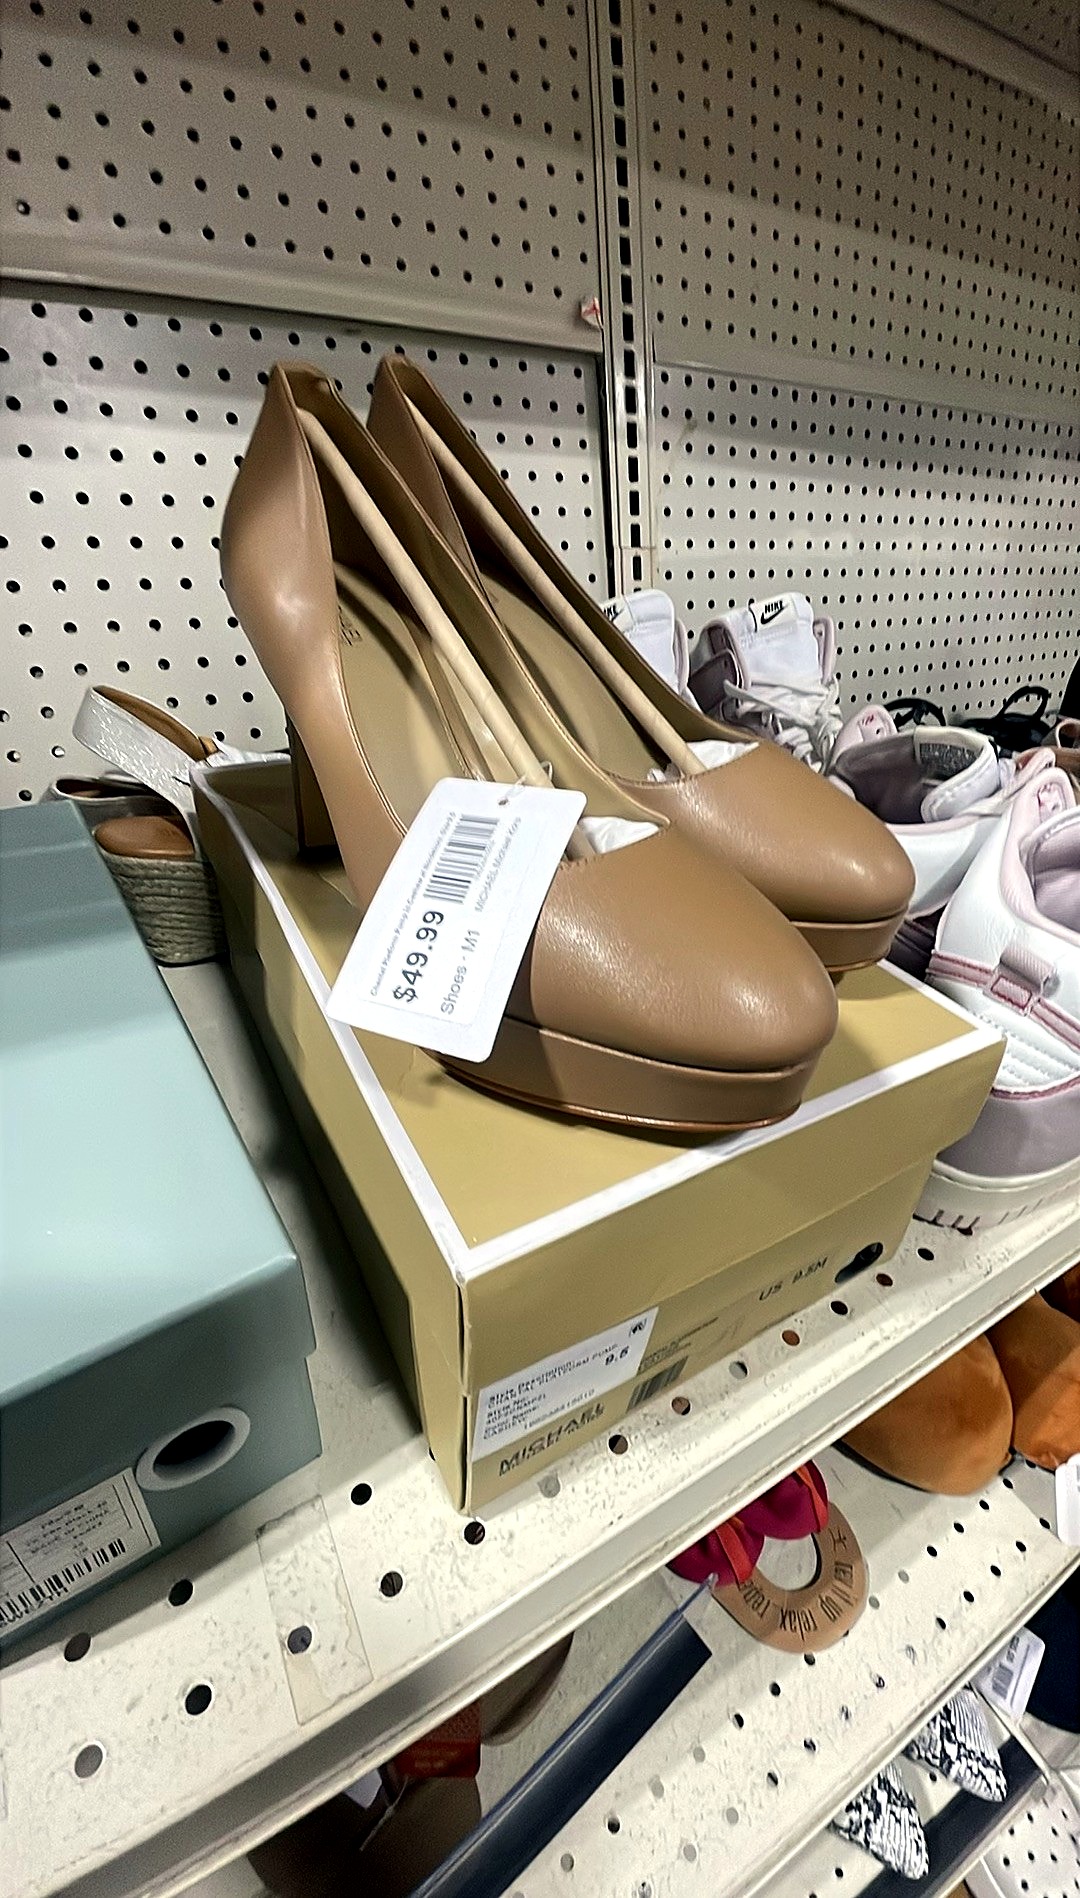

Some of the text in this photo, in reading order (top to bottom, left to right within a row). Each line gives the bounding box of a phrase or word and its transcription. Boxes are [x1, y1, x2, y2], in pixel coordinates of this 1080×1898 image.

[765, 600, 783, 613] NIKE
[393, 910, 444, 1002] $49.99
[440, 965, 467, 1015] Shoes
[758, 1281, 783, 1301] US
[779, 1608, 818, 1641] relax
